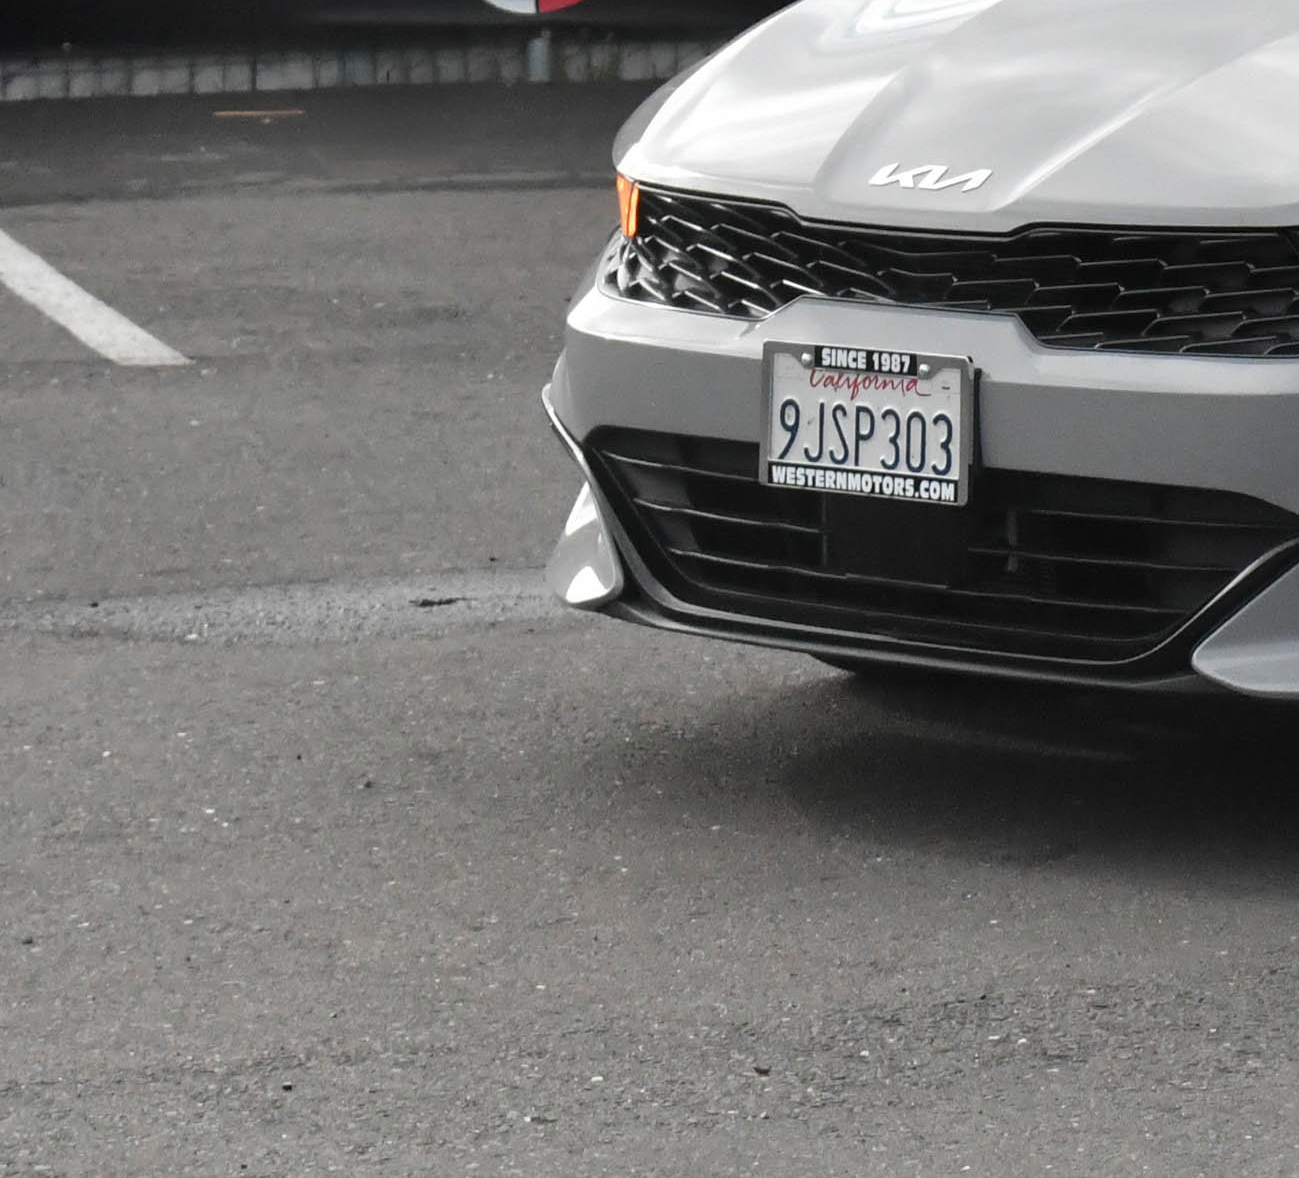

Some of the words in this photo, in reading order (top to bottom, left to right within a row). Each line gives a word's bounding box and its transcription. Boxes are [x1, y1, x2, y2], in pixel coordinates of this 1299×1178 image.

[821, 347, 866, 369] SINCE
[871, 350, 911, 373] 1987
[808, 368, 931, 401] California
[777, 397, 953, 477] 9JSP303
[772, 465, 956, 502] WESTERNMOTORS.COM
